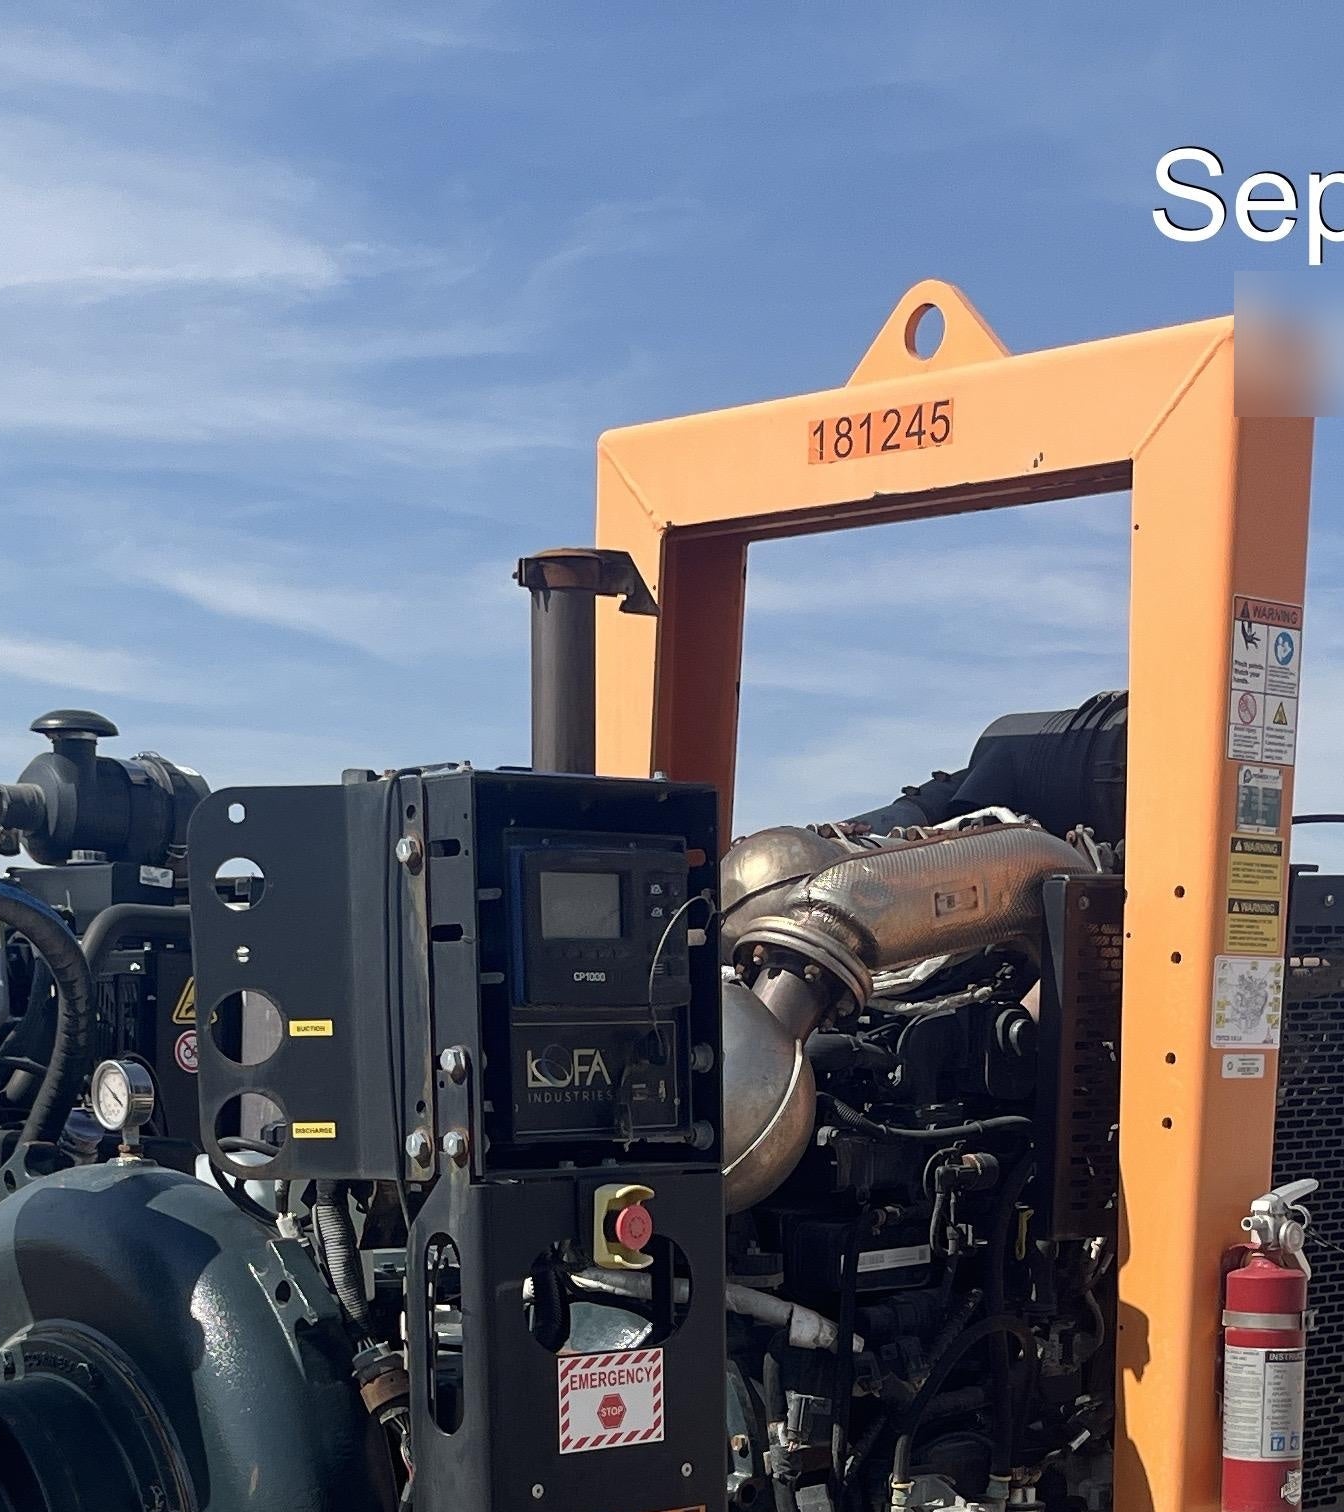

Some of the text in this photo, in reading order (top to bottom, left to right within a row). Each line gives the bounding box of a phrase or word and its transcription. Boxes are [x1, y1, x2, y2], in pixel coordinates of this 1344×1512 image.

[812, 399, 951, 461] 181245
[1252, 605, 1298, 625] WARNING
[1243, 841, 1278, 854] WARNING
[1240, 902, 1275, 914] WARNING
[528, 1089, 614, 1104] INDUSTRIES
[570, 1366, 653, 1391] EMERGENCY
[600, 1406, 624, 1418] STOP
